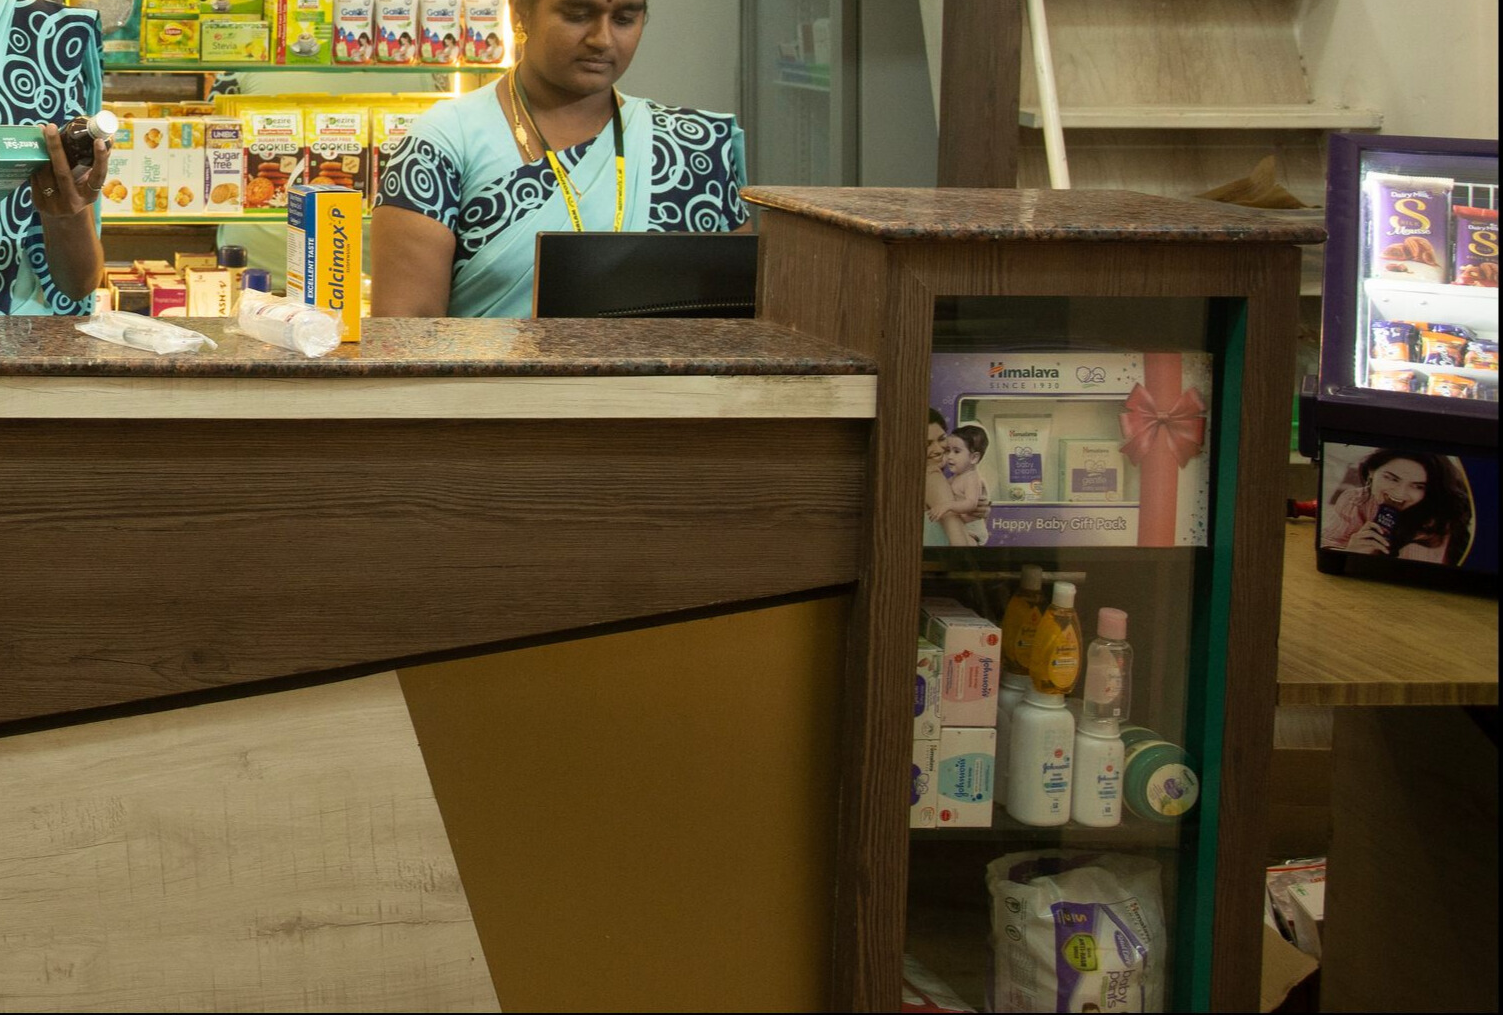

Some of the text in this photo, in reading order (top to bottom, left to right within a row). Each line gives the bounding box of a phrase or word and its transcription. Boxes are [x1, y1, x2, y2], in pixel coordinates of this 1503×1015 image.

[212, 41, 237, 50] Stevia
[213, 131, 237, 139] UNIBIC
[250, 143, 297, 152] COOKIES
[312, 143, 360, 152] COOKIES
[213, 150, 240, 162] Sugar
[213, 160, 232, 169] free
[1391, 191, 1412, 200] Dairy
[1468, 224, 1482, 232] Dairy
[307, 260, 315, 299] EXCELLENT
[989, 362, 1060, 379] Himalaya
[1015, 461, 1034, 469] baby
[1014, 467, 1038, 475] cream
[1081, 476, 1107, 485] gentle
[992, 517, 1127, 532] Happy Baby Gift Pack
[978, 656, 993, 699] Johnson's
[954, 757, 967, 799] Johnson's
[1106, 971, 1121, 1009] pants
[1116, 969, 1136, 1004] baby
